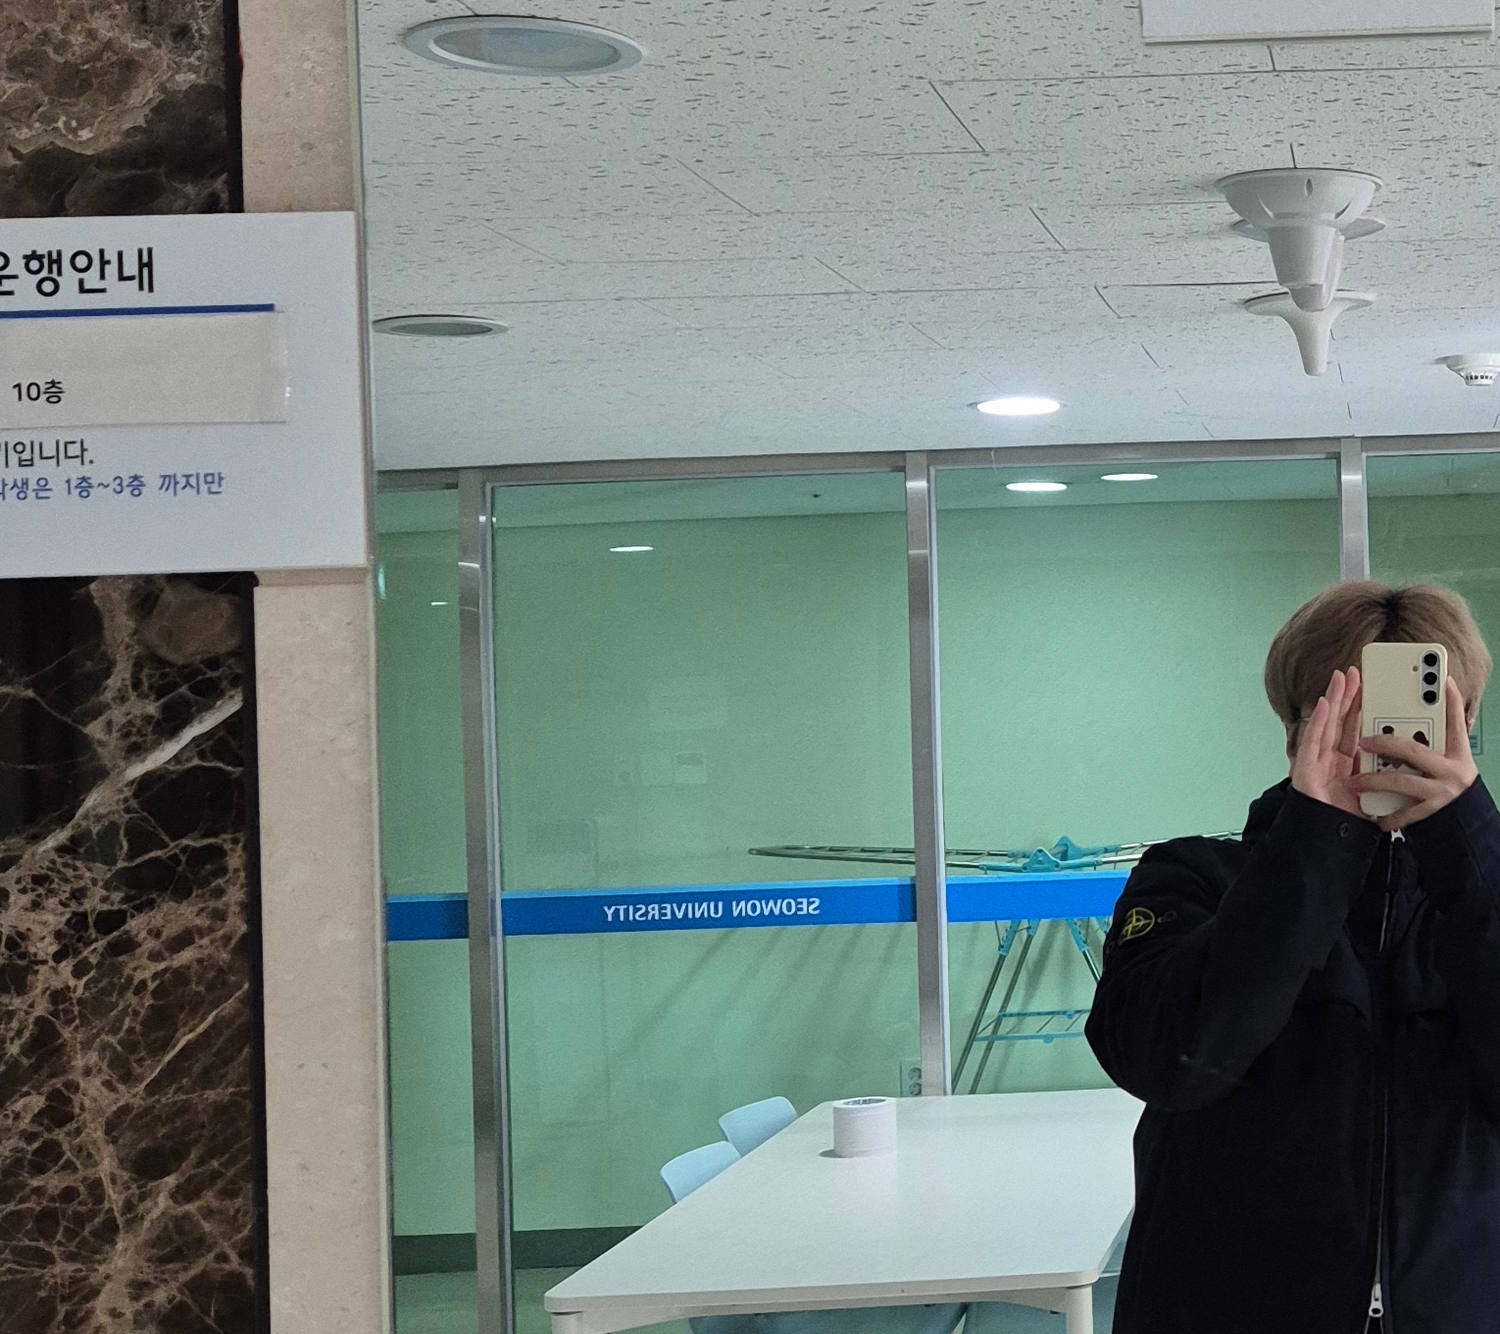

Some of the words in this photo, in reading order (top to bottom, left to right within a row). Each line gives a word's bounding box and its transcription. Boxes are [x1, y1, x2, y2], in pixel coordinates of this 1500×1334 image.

[11, 378, 66, 404] 10층
[64, 474, 147, 499] 1층~3층
[158, 471, 225, 496] 까지만
